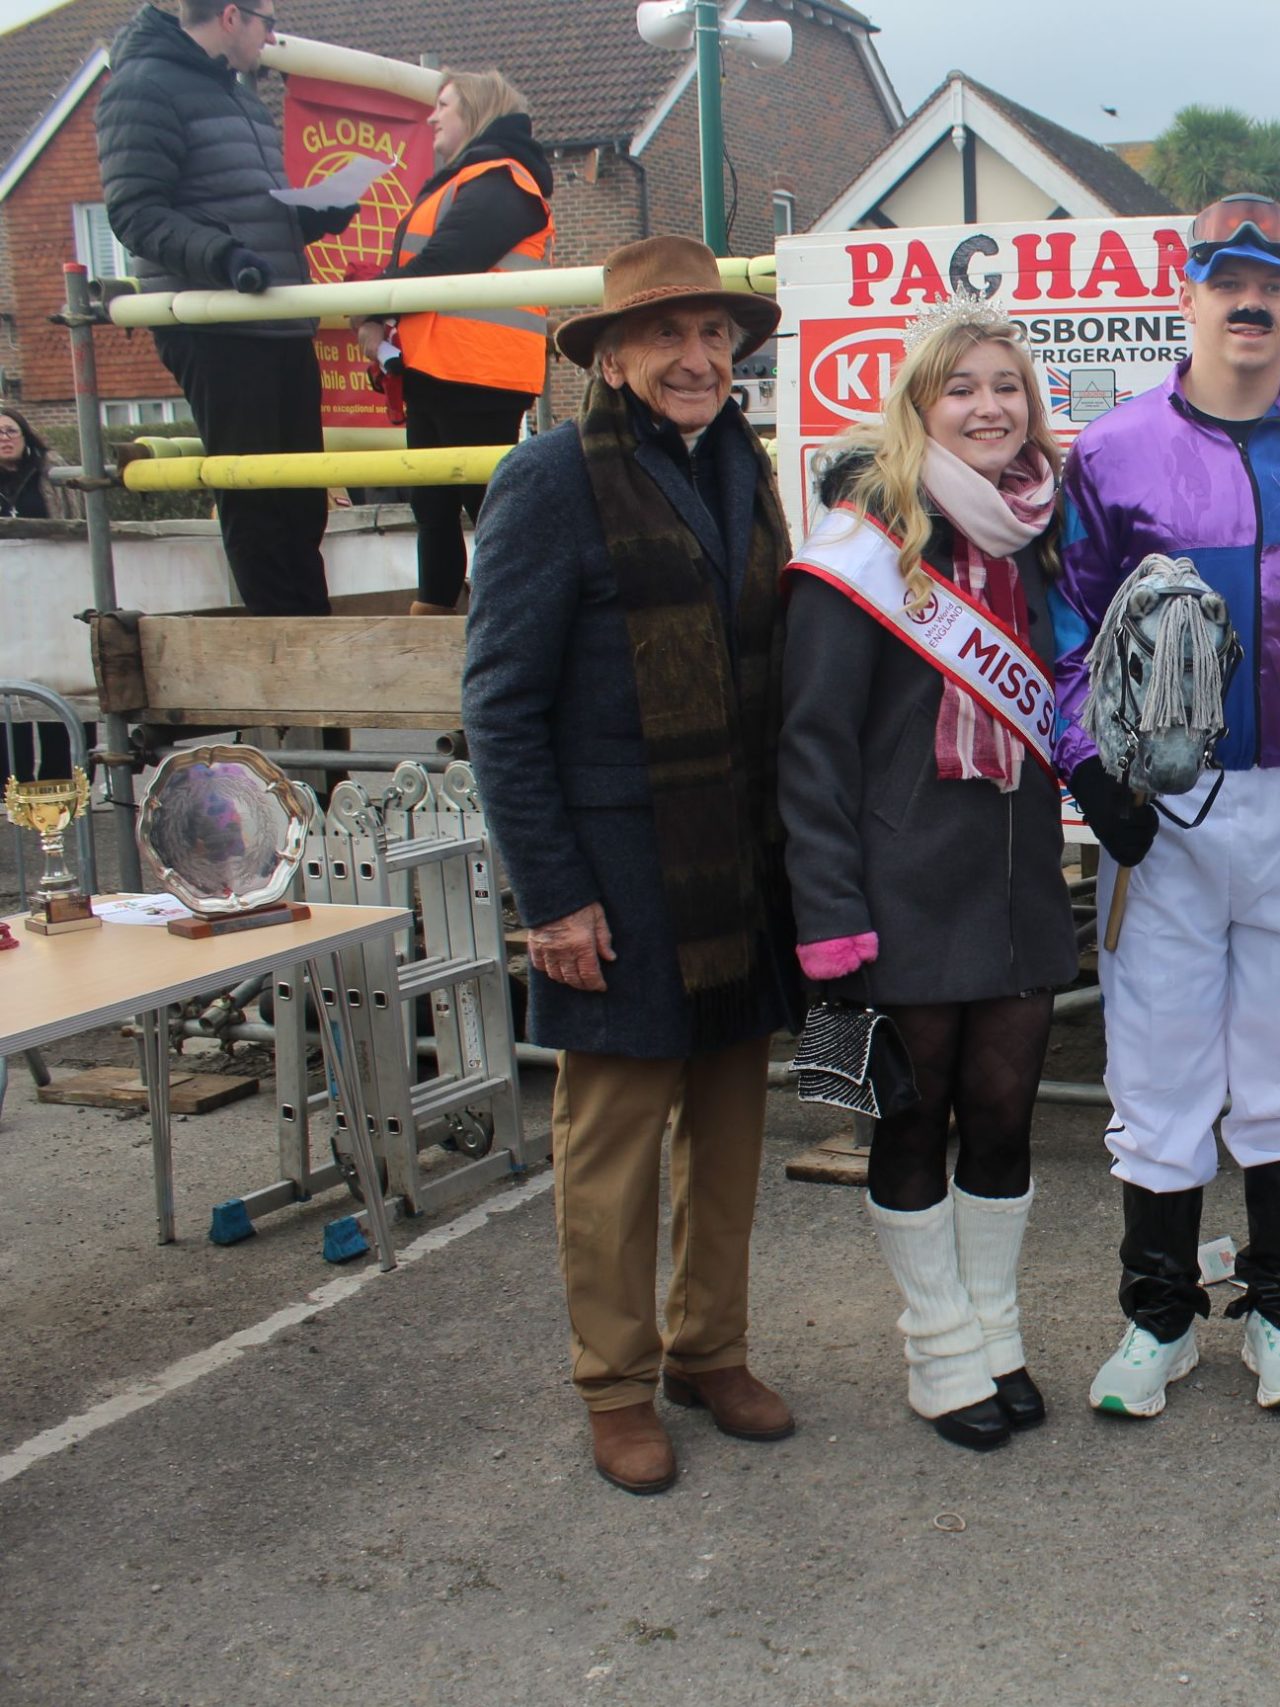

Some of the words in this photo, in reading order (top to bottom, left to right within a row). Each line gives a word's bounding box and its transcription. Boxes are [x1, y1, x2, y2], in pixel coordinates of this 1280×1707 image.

[303, 118, 408, 170] GLOBAL
[314, 340, 339, 362] fice
[1031, 347, 1188, 363] FRIGERATORS
[321, 370, 346, 391] bile
[835, 352, 892, 400] KI
[924, 622, 940, 639] Miss
[935, 601, 954, 625] World
[929, 605, 964, 648] ENGLAND
[957, 627, 1041, 716] MISS
